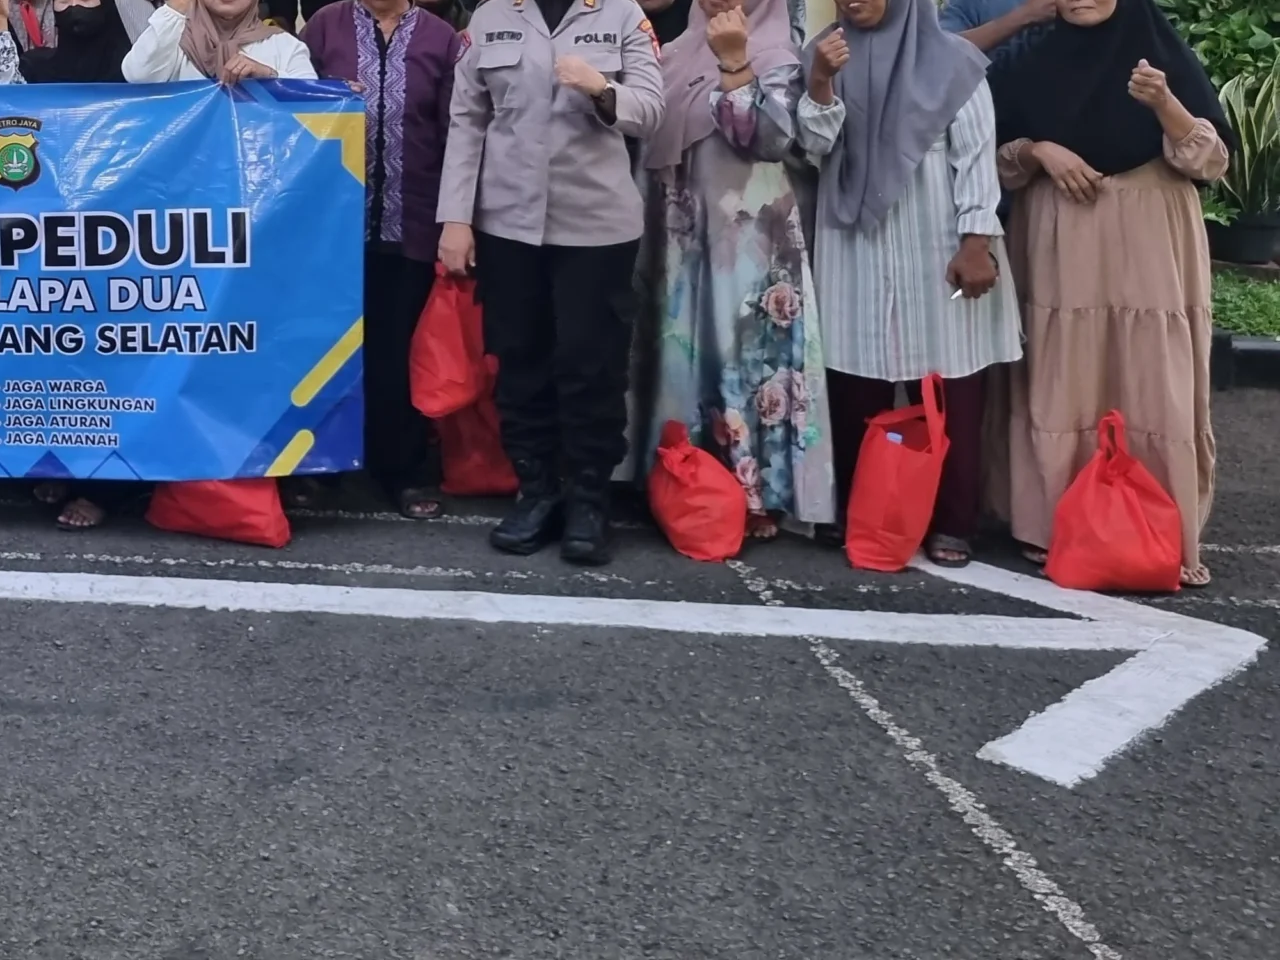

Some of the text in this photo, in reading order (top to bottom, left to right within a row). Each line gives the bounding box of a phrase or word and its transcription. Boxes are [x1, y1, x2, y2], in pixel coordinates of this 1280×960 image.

[574, 33, 618, 44] POLRI
[18, 119, 38, 129] JAYA
[108, 276, 207, 311] DUA
[96, 321, 257, 355] SELATAN
[3, 380, 107, 394] JAGA WARGA
[3, 398, 156, 412] JAGA LINGKUNGAN
[4, 415, 112, 429] JAGA ATURAN
[4, 432, 119, 447] JAGA AMANAH
